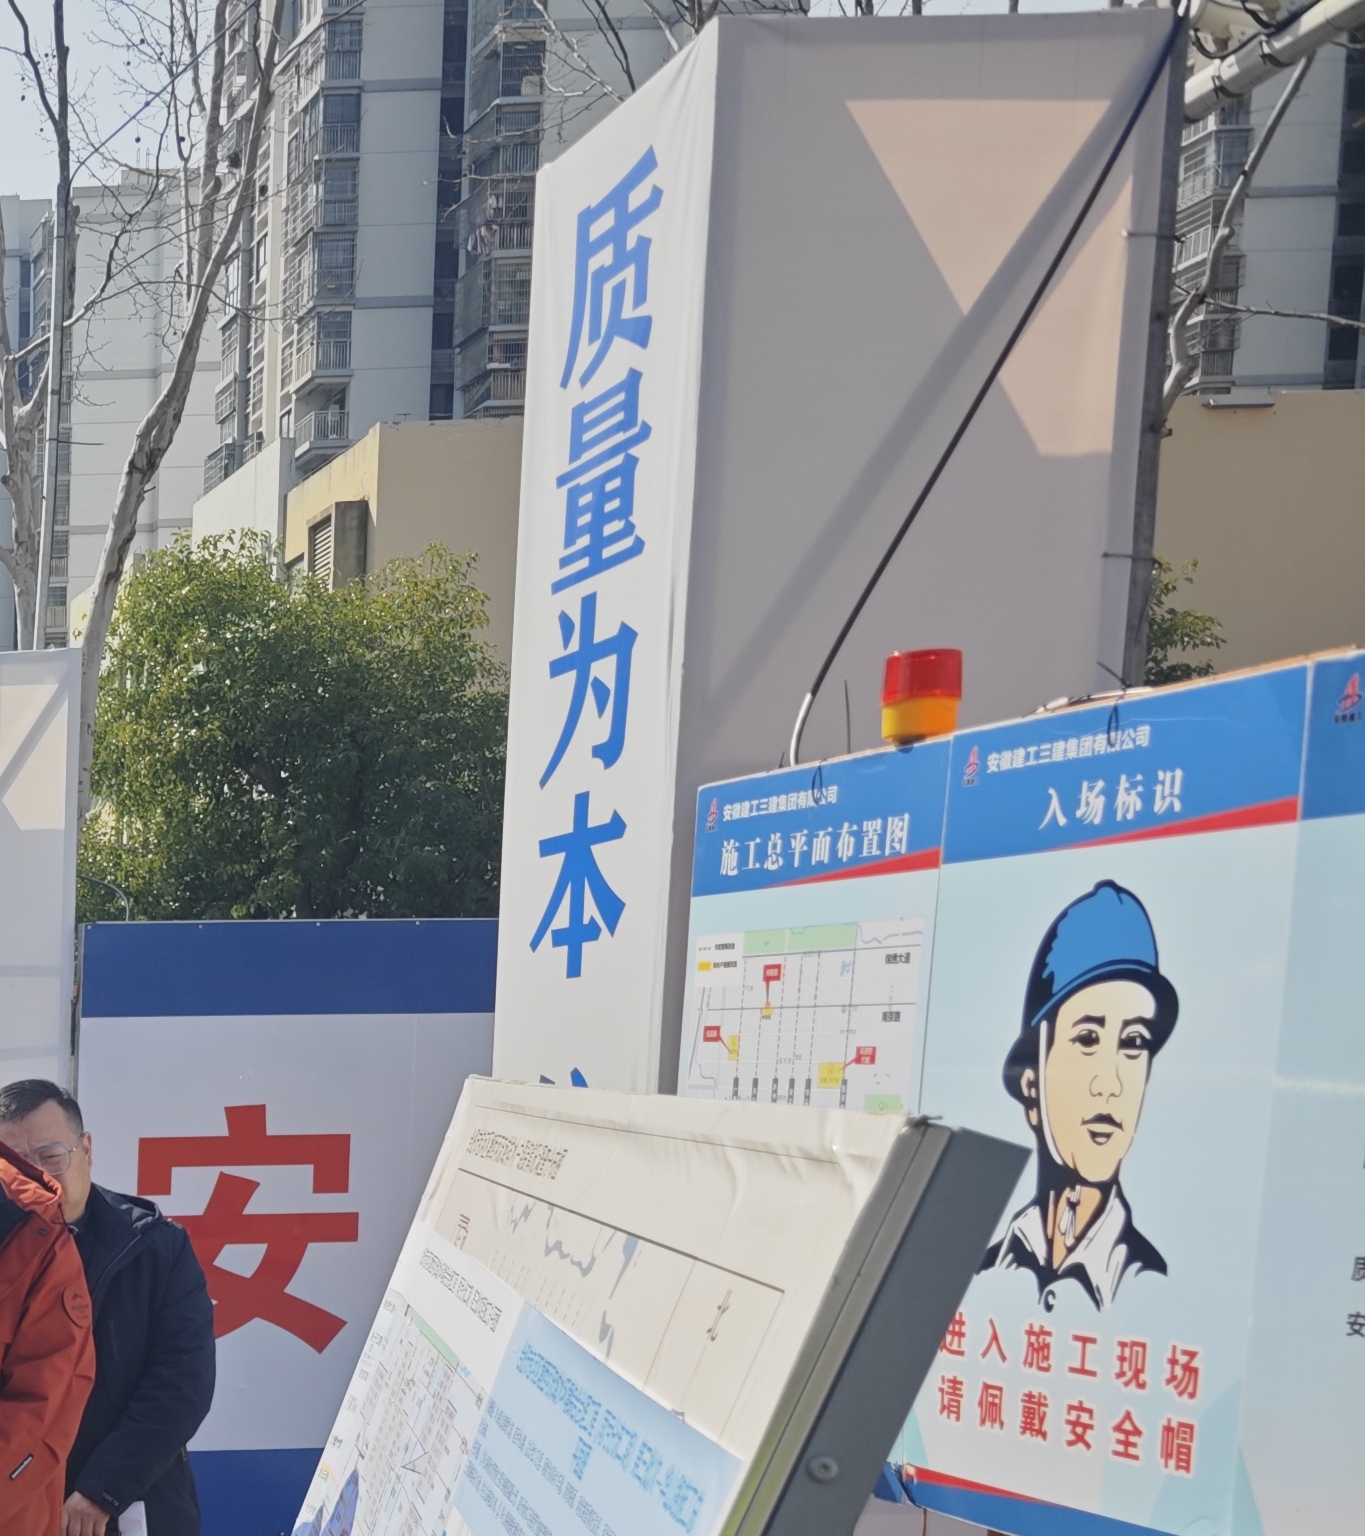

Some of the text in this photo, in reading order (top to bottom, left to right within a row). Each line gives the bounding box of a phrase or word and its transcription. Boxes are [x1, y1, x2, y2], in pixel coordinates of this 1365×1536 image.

[529, 144, 664, 979] 质量为本
[986, 725, 1151, 773] 安徽建工三建集团有限公司
[722, 785, 839, 822] 安徽建工三建集团有限公司
[1038, 768, 1184, 831] 入场标识
[719, 813, 910, 876] 施工总平面布置图
[137, 1104, 359, 1354] 安
[939, 1312, 1202, 1400] 进入施工现场
[937, 1375, 1195, 1474] 请佩戴安全帽
